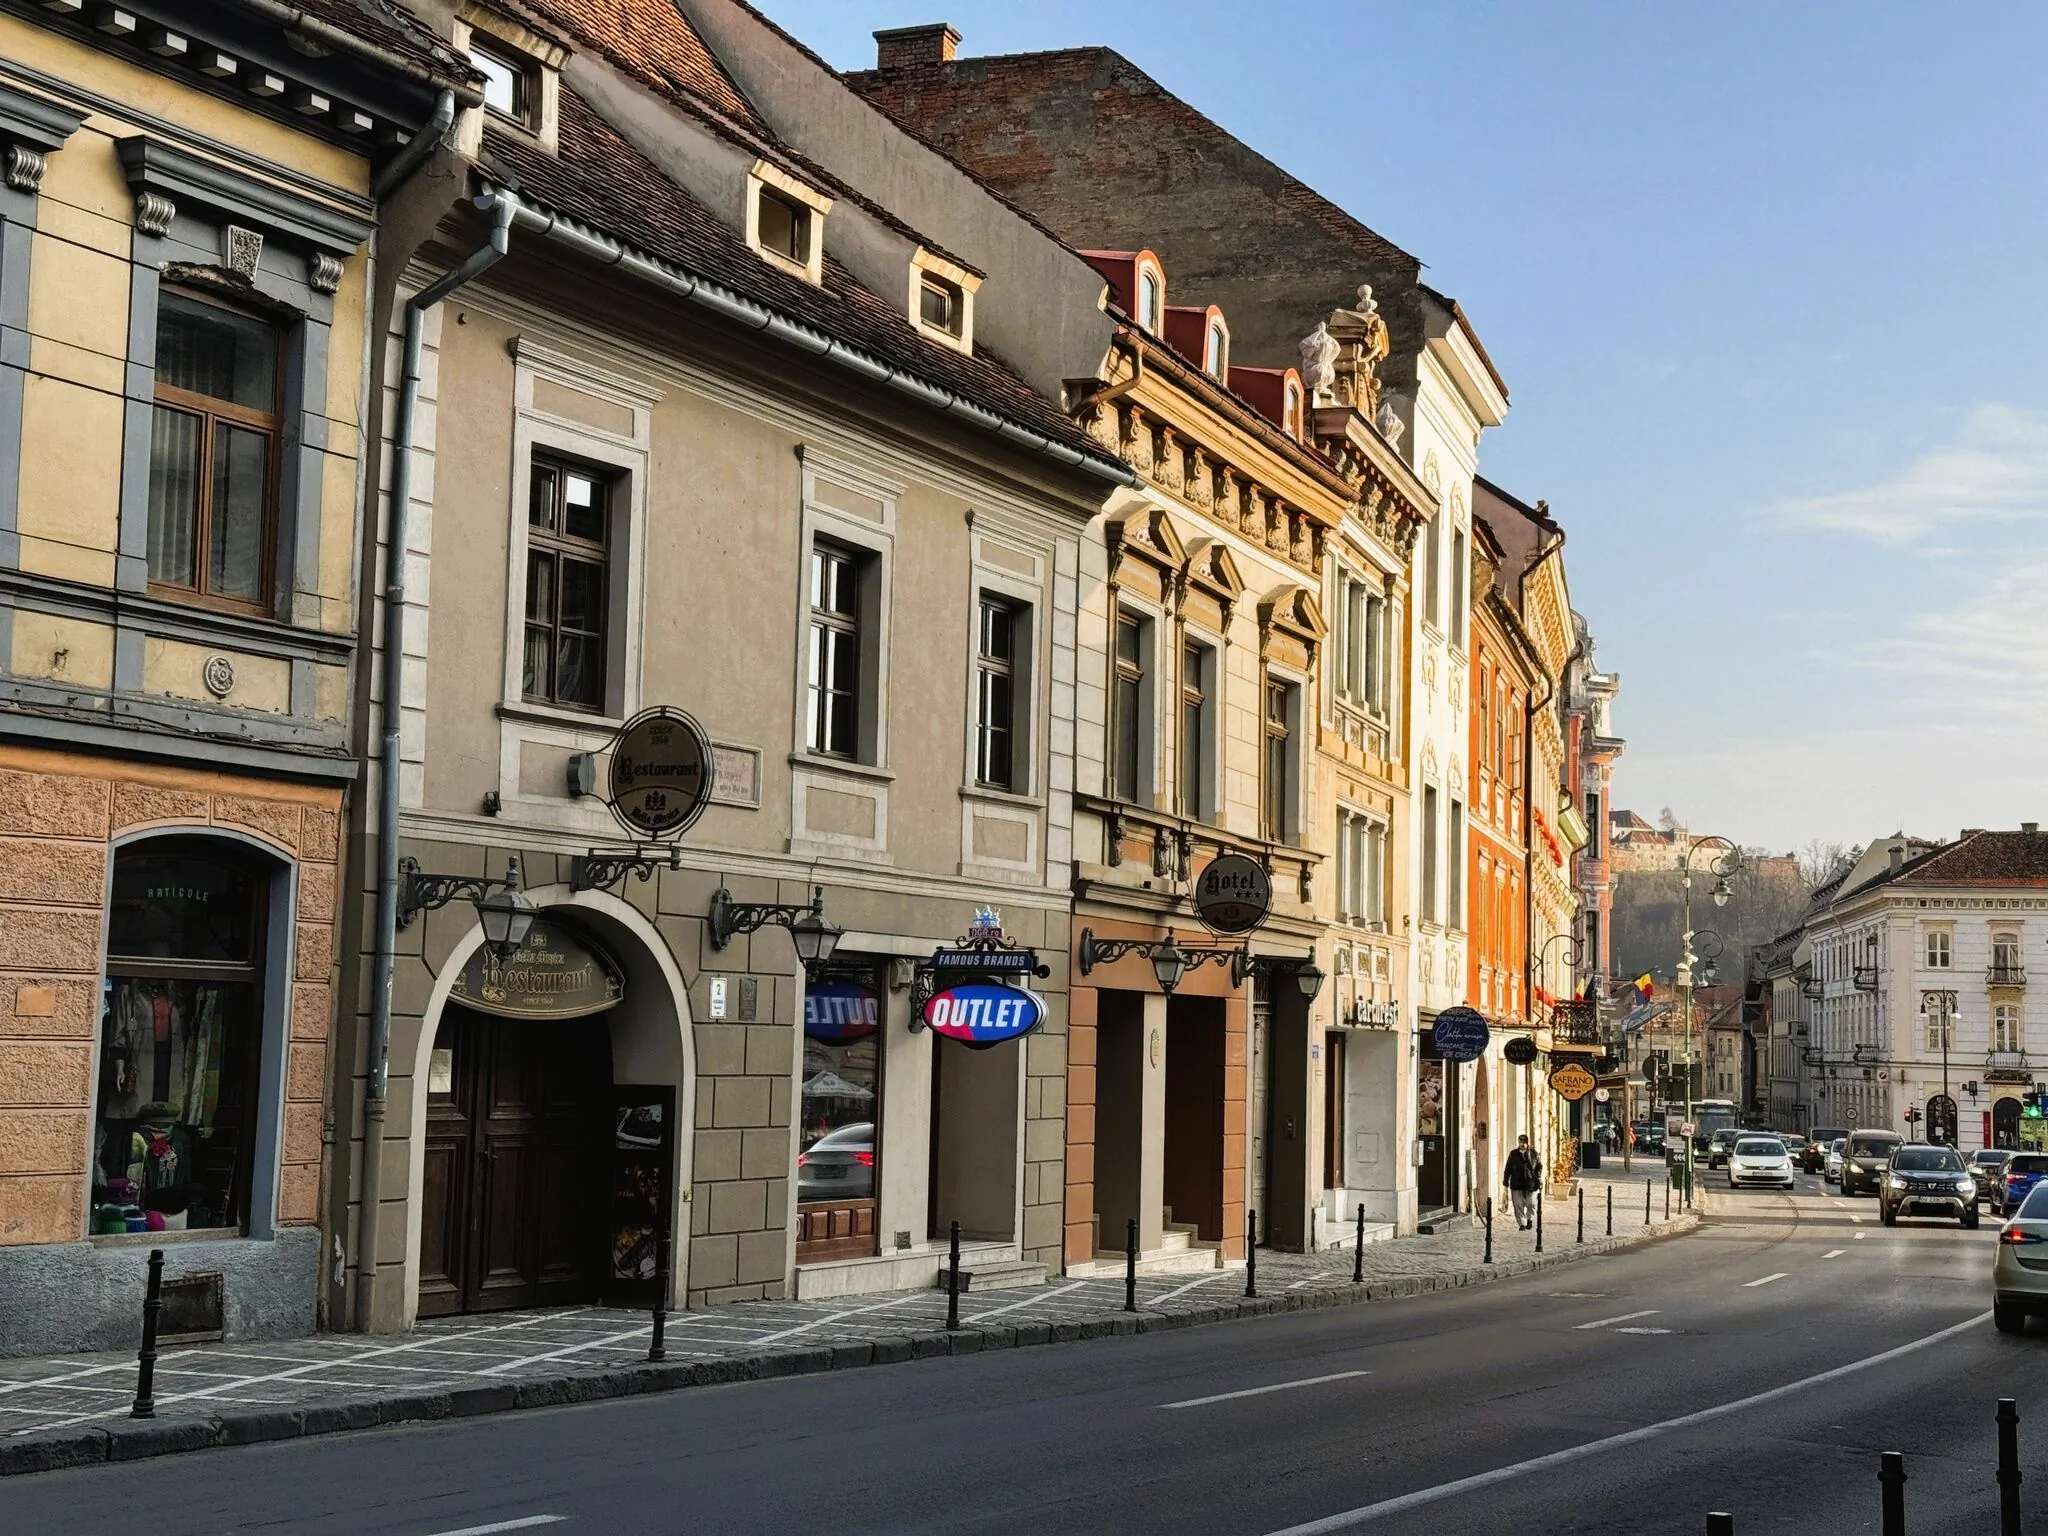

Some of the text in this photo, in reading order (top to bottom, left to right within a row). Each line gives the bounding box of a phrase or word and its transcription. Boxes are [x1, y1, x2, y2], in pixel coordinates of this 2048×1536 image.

[617, 754, 699, 784] Restaurant
[1205, 868, 1256, 896] Hotel
[971, 928, 1000, 938] DGR.ro
[938, 954, 1026, 967] FAMOUS BRANDS
[482, 944, 594, 1001] Restaurant
[716, 983, 721, 996] 2
[932, 998, 1027, 1028] OUTLET
[1553, 1075, 1593, 1086] SAFRANO
